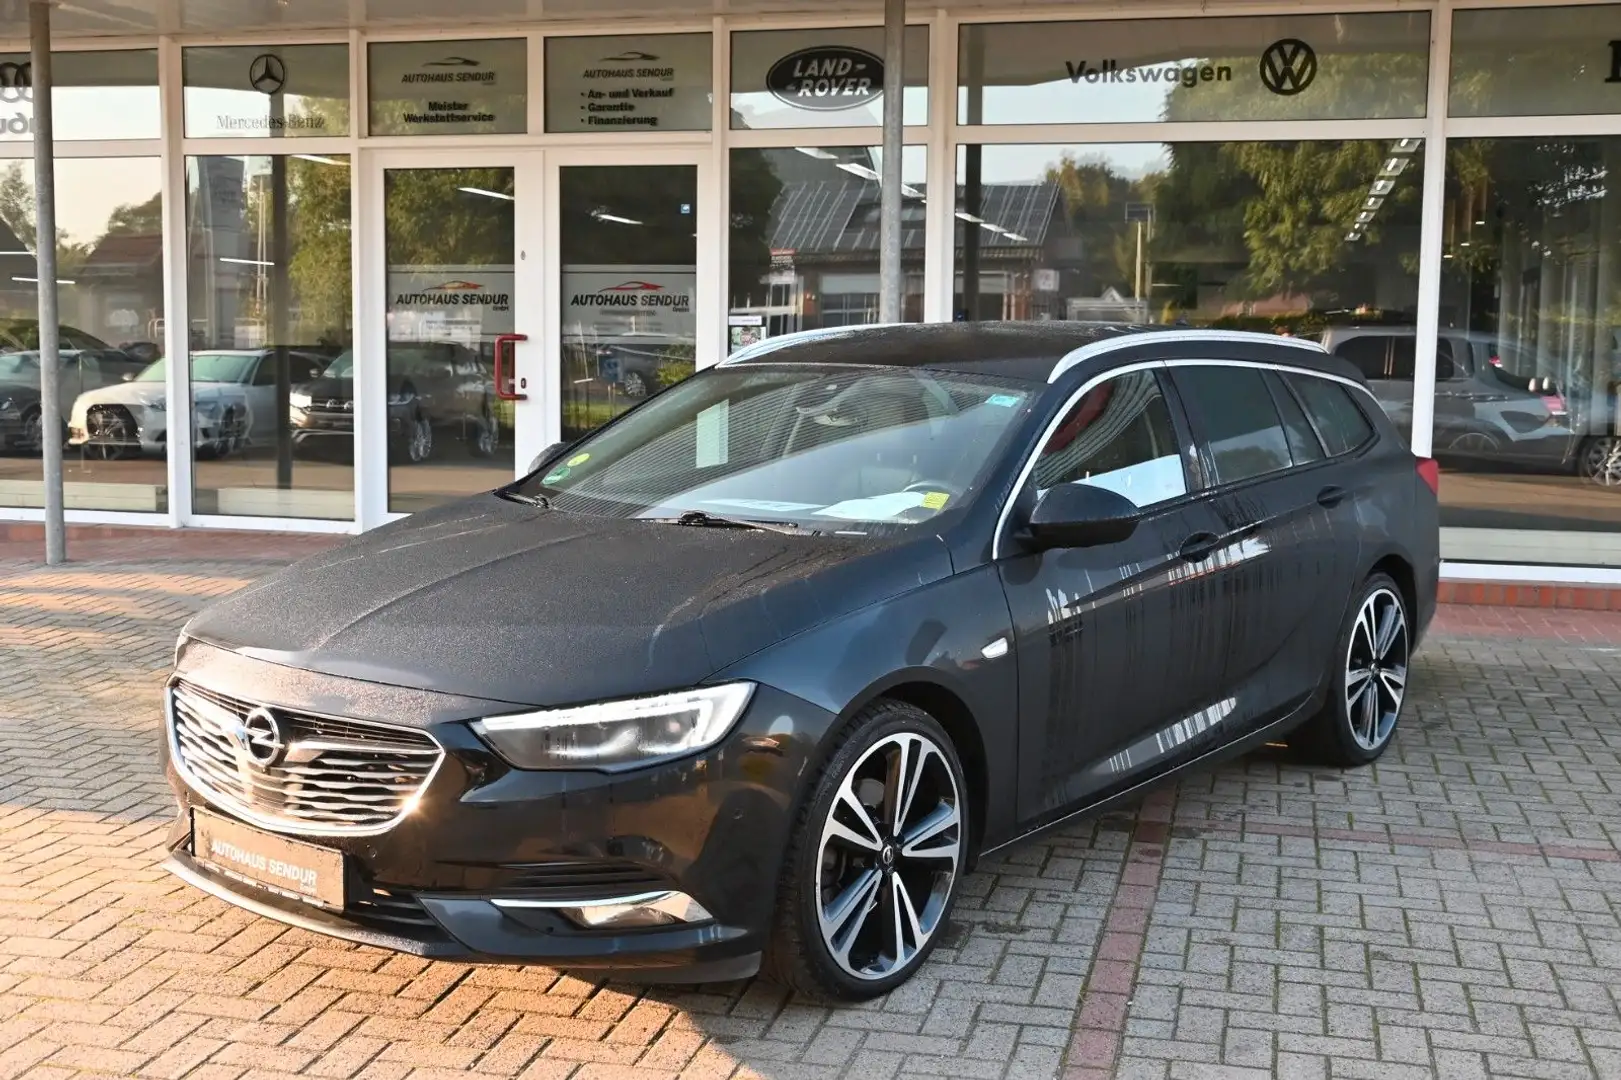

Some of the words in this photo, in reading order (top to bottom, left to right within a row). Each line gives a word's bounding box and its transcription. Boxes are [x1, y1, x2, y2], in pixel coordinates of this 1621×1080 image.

[401, 72, 454, 84] AUTOHAUS
[456, 71, 496, 82] SENDUR
[583, 68, 634, 79] AUTOHAUS
[636, 67, 674, 78] SENDUR
[1065, 59, 1233, 88] Volkswagen
[608, 88, 630, 98] und
[632, 87, 675, 98] Verkauf
[428, 101, 470, 111] Meister
[587, 102, 636, 112] Garantie
[216, 114, 325, 130] Mercedes-Benz
[403, 112, 496, 123] Werkstattservice
[587, 115, 659, 126] Finanzierung
[396, 293, 460, 306] AUTOHAUS
[461, 293, 509, 305] SENDUR
[570, 294, 638, 307] AUTOHAUS
[640, 294, 690, 307] SENDUR
[211, 840, 267, 870] AUTOHAUS
[268, 859, 317, 885] SENDUR
